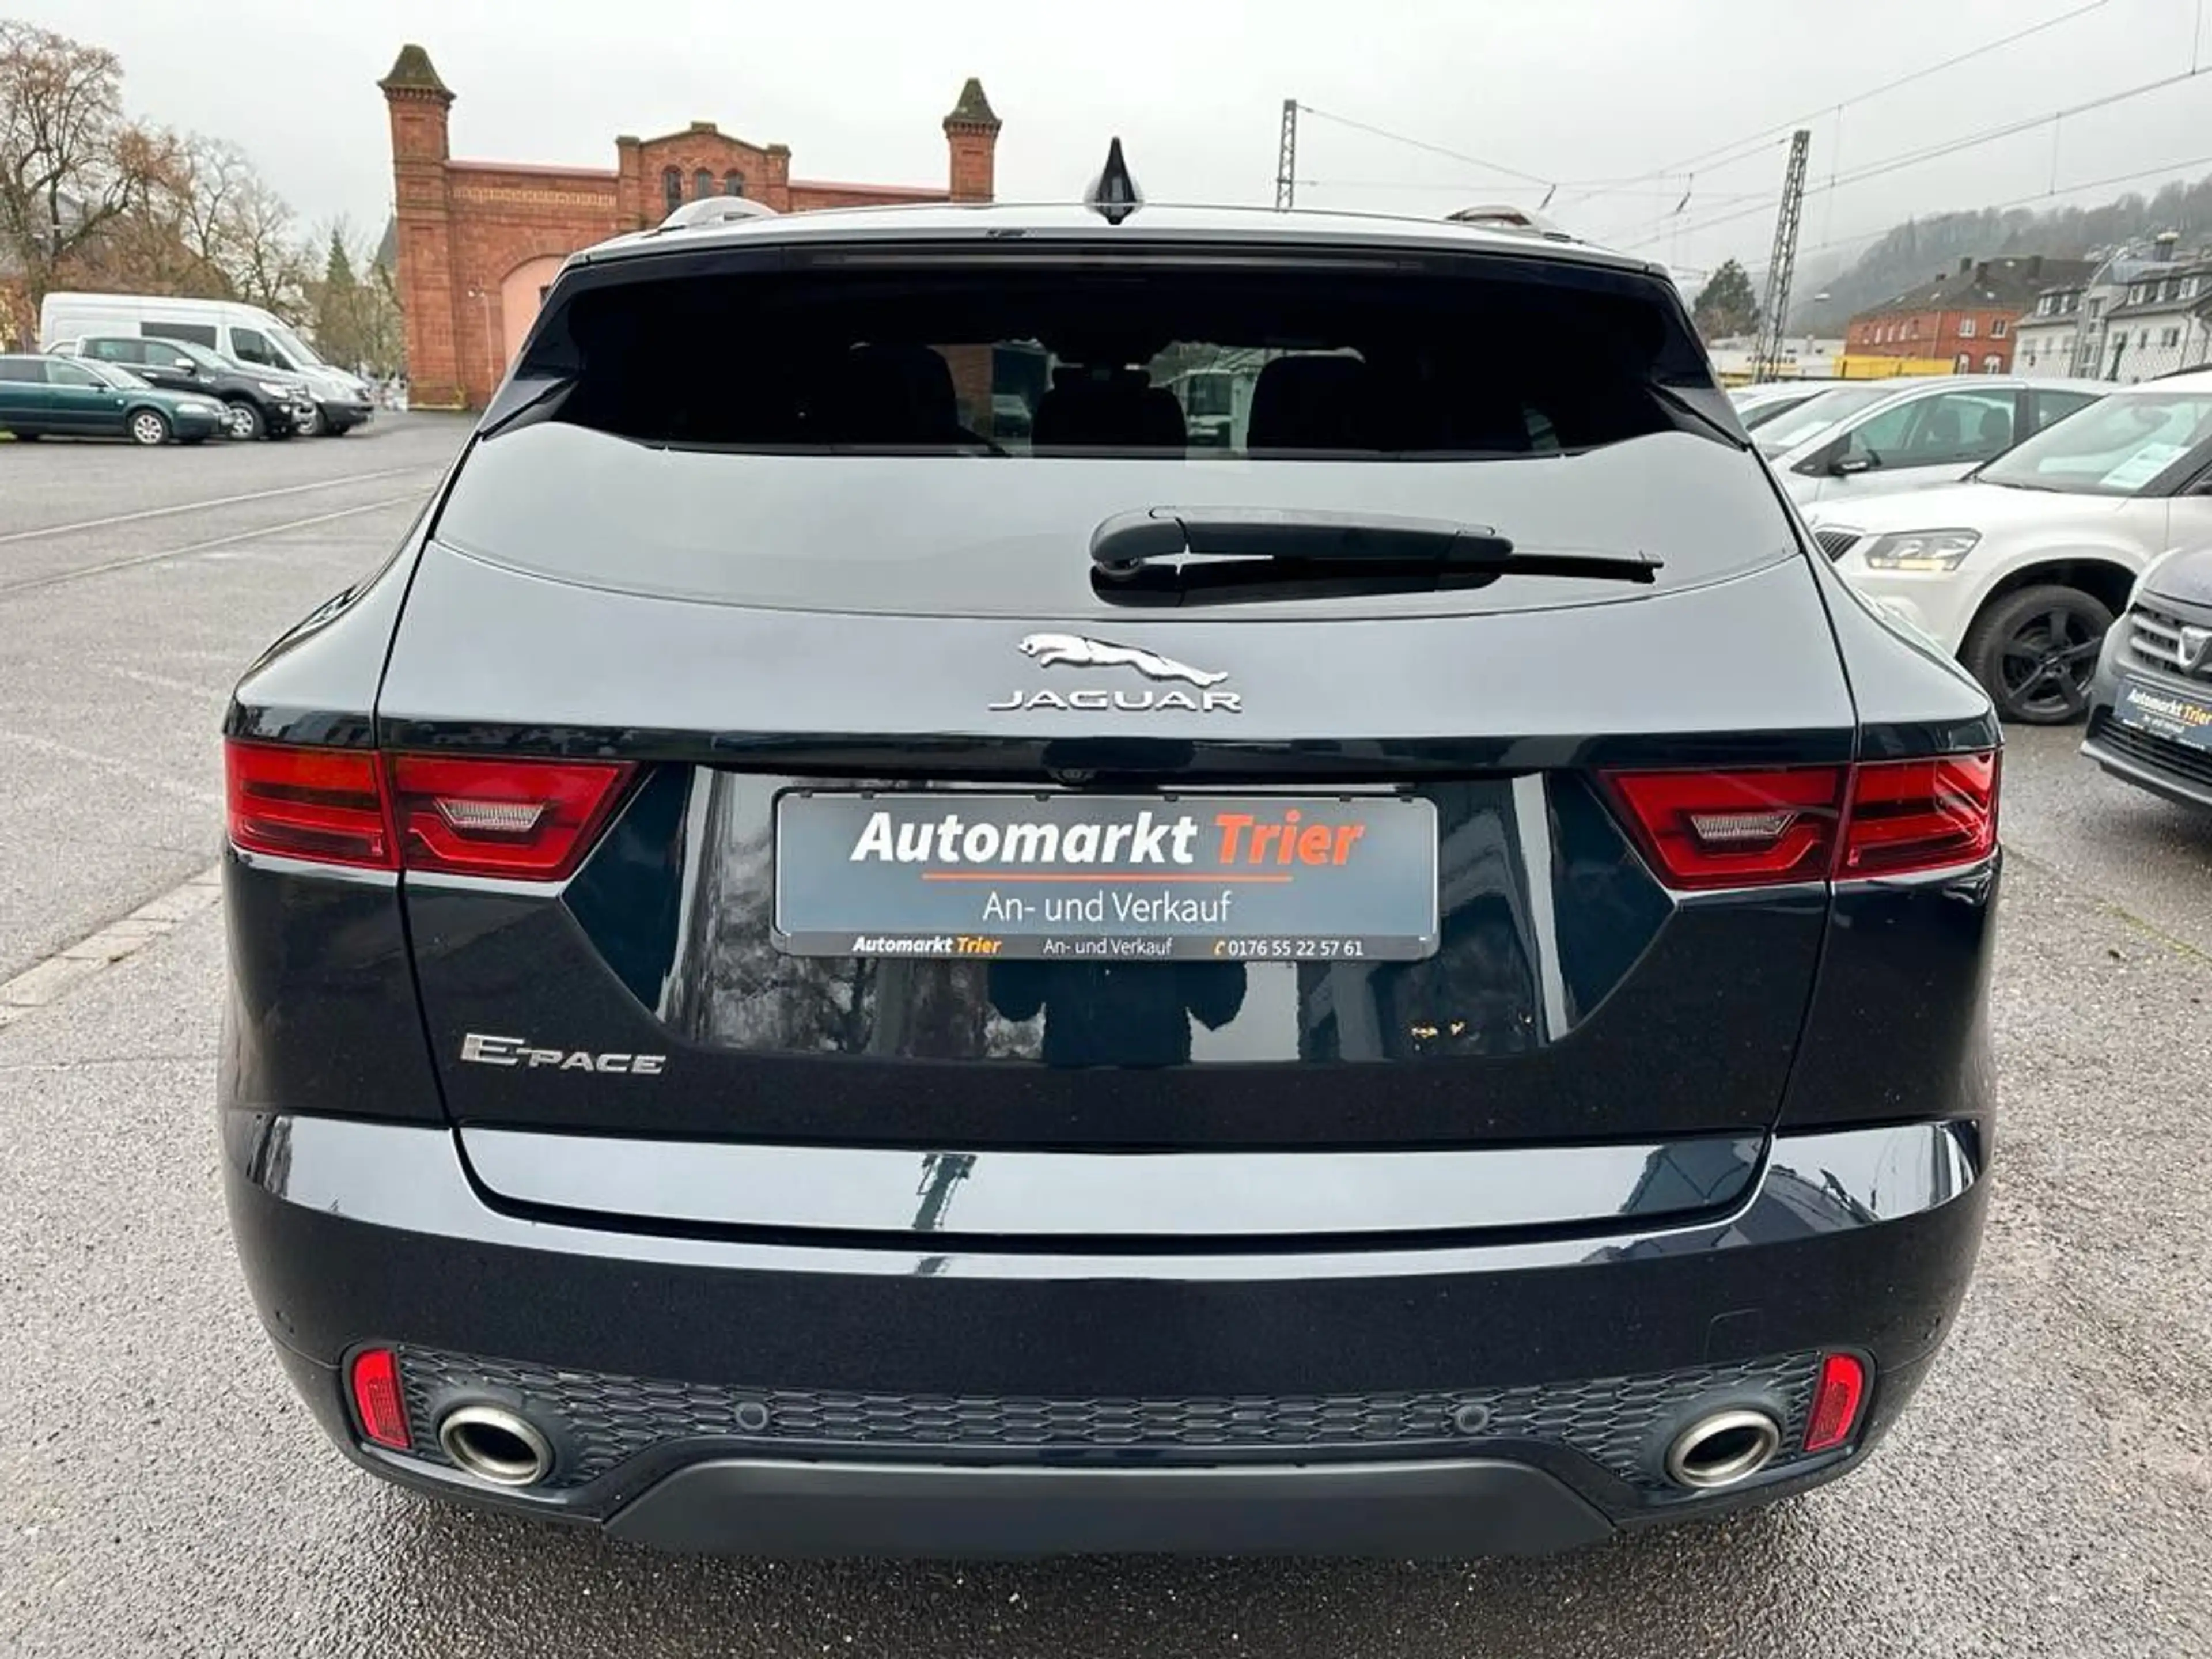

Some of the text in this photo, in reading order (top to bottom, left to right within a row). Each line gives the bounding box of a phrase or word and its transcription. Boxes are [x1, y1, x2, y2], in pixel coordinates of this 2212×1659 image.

[988, 690, 1243, 712] JAGUAR
[850, 809, 1365, 865] Automarkt Trier
[982, 890, 1233, 923] An- und Verkauf
[852, 935, 1002, 955] Automarkt Trier
[1043, 938, 1173, 955] An- und Verkauf
[1228, 940, 1364, 956] 0176 55 22 57 61
